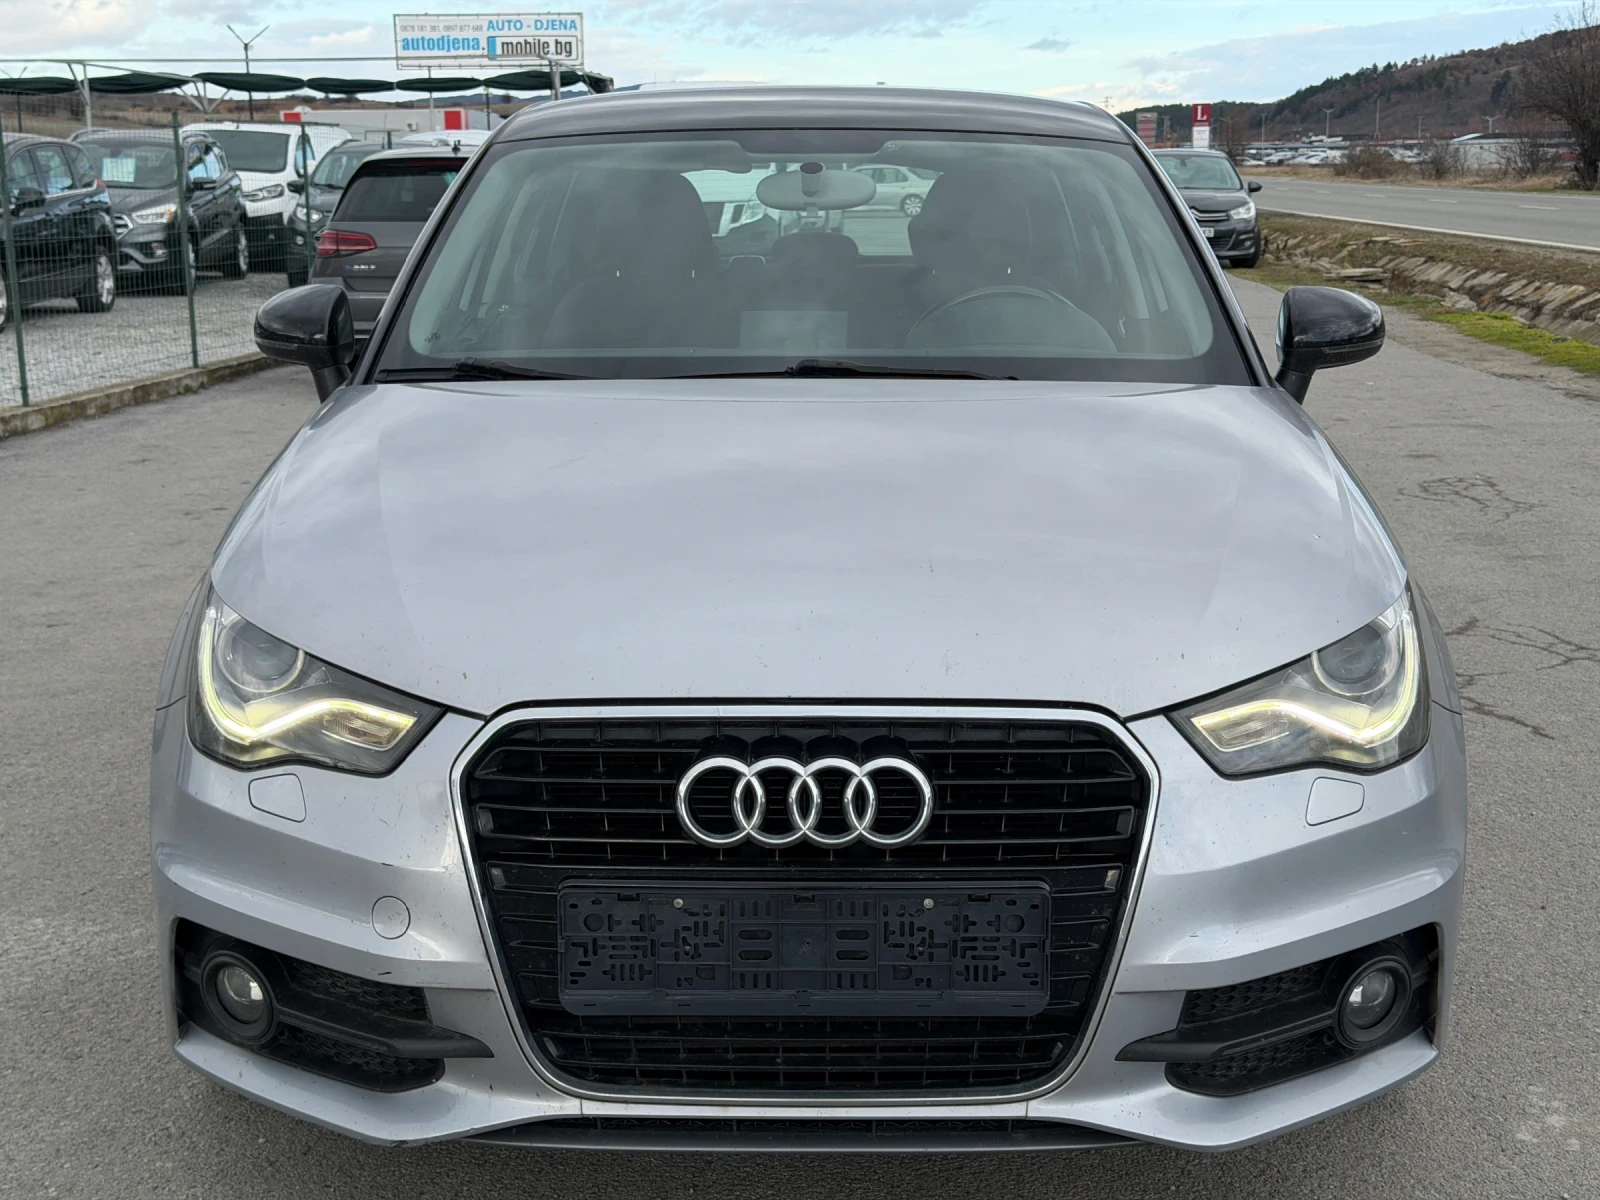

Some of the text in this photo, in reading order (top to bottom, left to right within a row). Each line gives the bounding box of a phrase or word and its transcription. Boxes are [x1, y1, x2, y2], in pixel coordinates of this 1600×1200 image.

[487, 19, 523, 31] AUTO
[534, 19, 578, 31] DJENA
[1196, 105, 1208, 121] L
